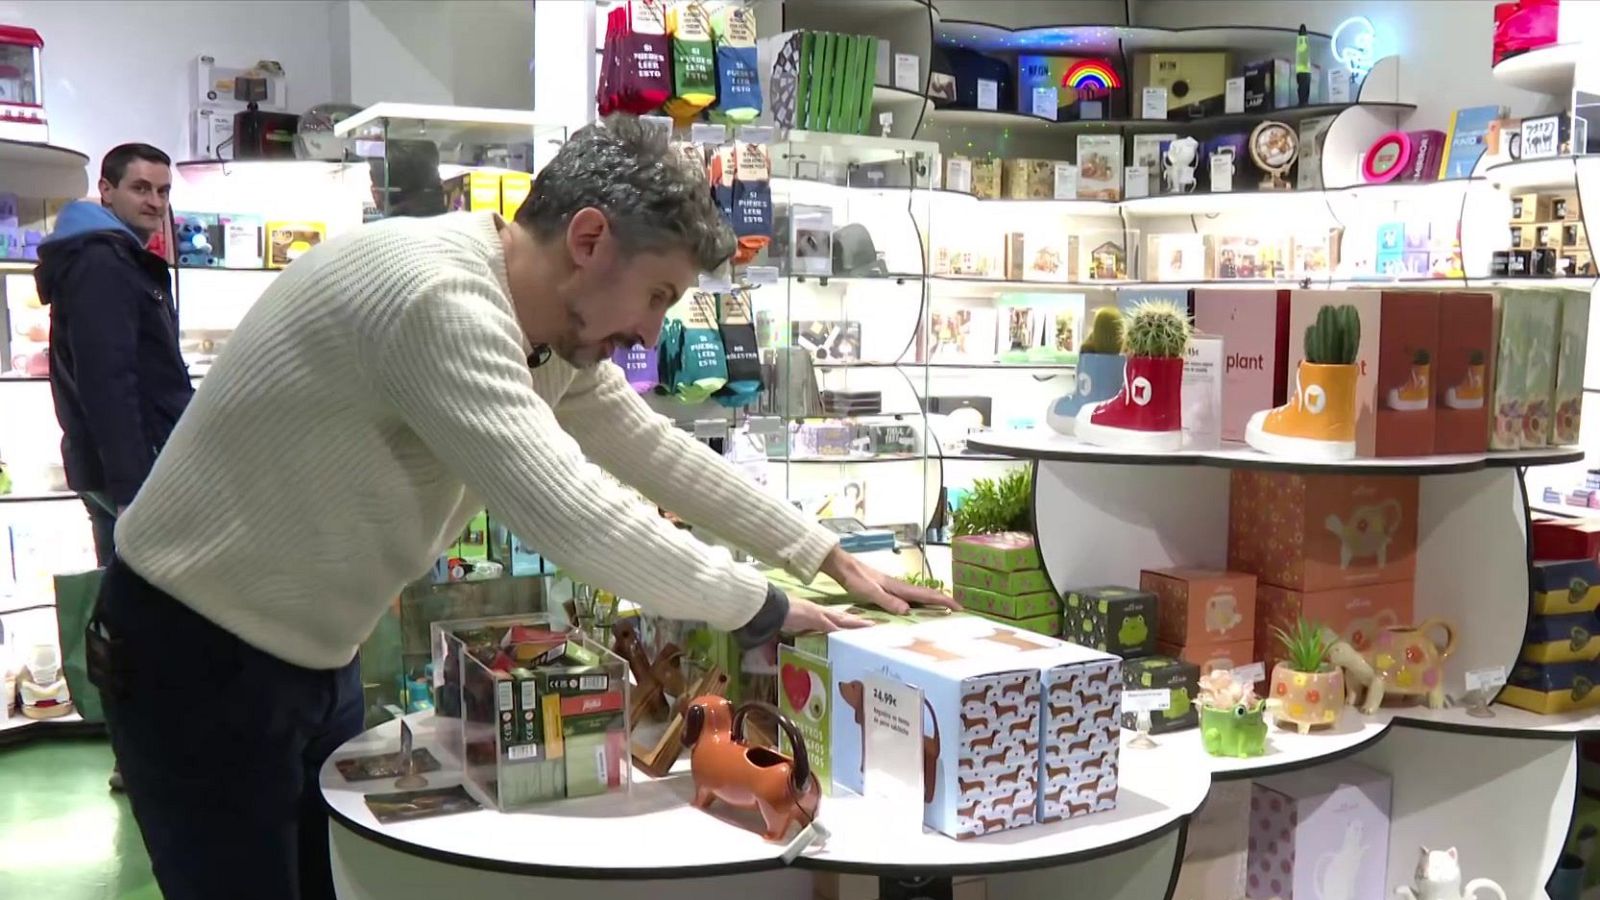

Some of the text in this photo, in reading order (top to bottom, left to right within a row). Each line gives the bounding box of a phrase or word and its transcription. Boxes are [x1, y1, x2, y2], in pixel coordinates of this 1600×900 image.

[638, 61, 659, 69] LEER
[638, 70, 661, 78] ESTO
[738, 199, 768, 208] PUEDES
[698, 359, 718, 367] ESTO
[1226, 352, 1264, 373] plant
